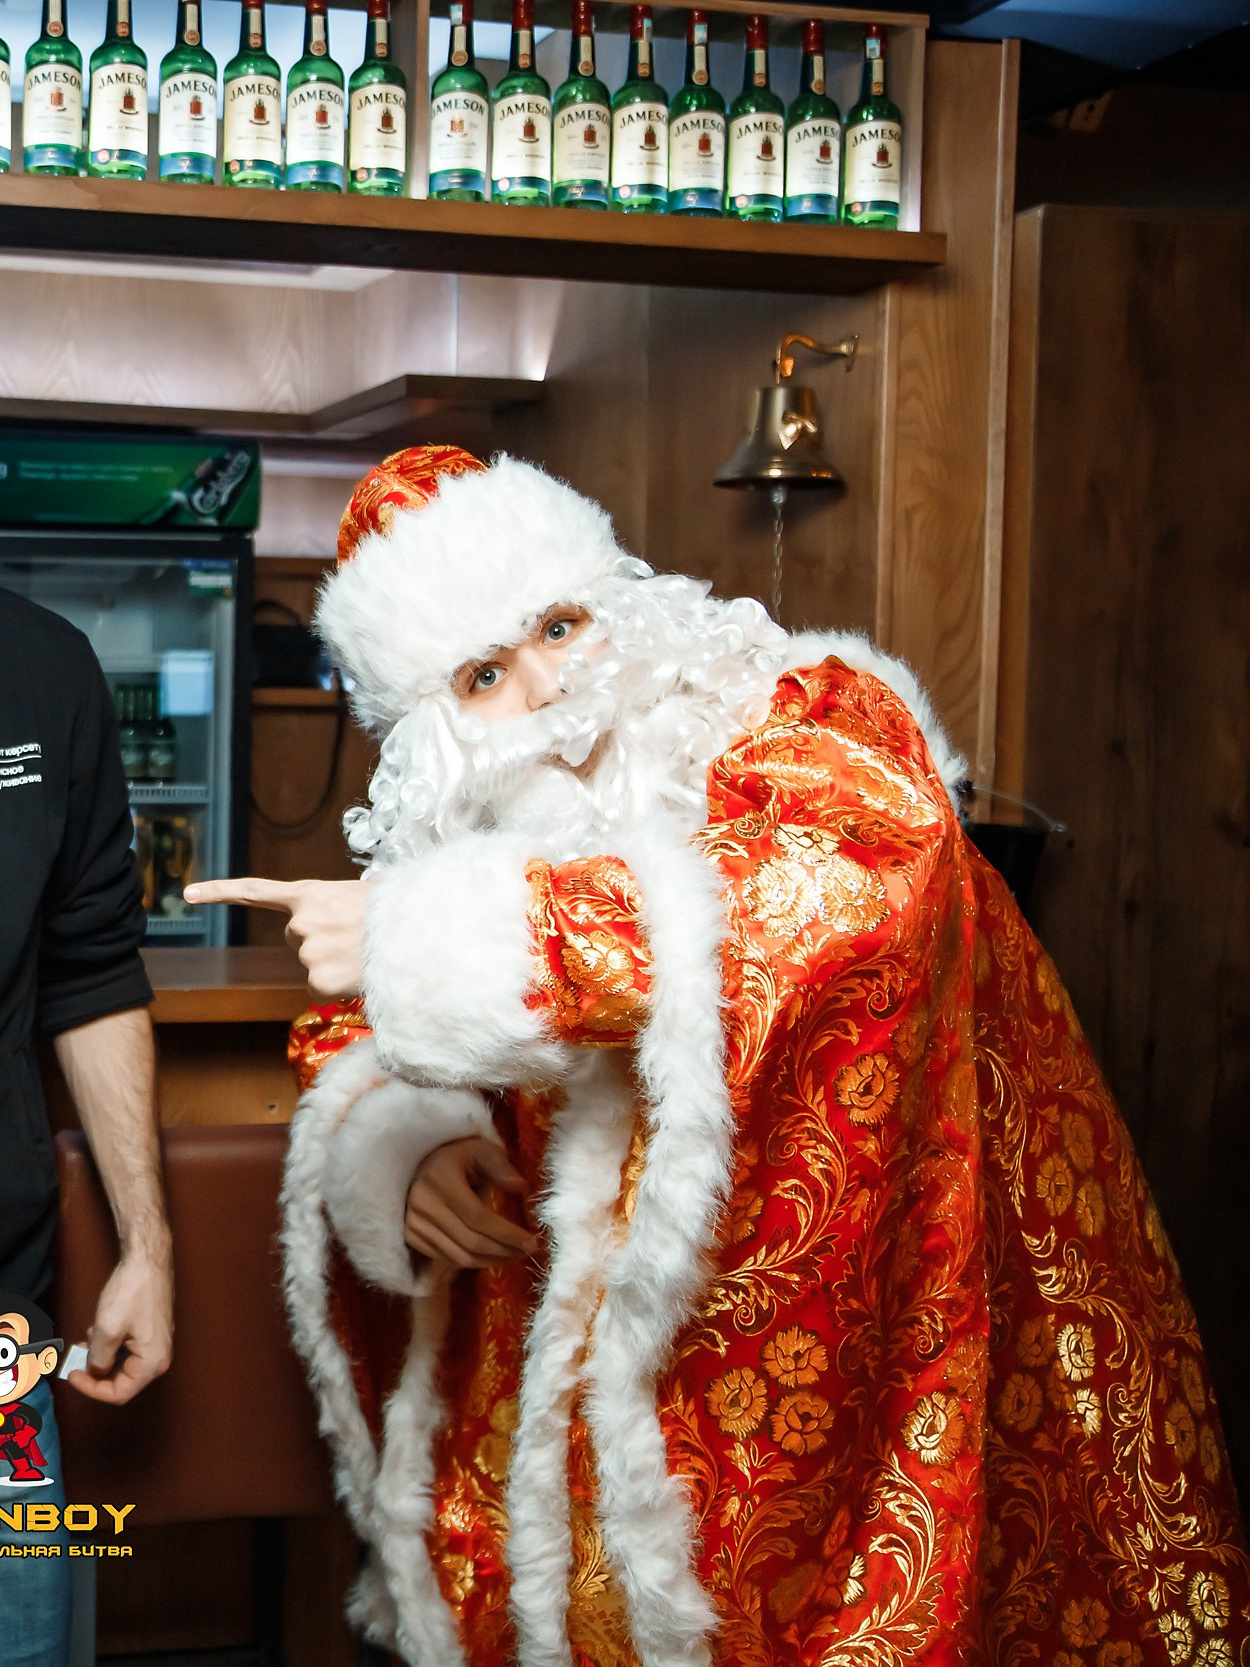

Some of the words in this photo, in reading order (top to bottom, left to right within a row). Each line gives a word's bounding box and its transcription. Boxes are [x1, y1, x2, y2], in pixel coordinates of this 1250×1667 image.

[98, 72, 147, 89] JAMESO
[166, 80, 217, 98] JAMESO
[230, 83, 280, 101] JAMESO
[357, 92, 406, 110] JAMESO
[560, 110, 609, 128] JAMESO
[620, 110, 666, 129] JAMESO
[675, 118, 724, 137] JAMESO
[852, 128, 900, 147] JAMESO
